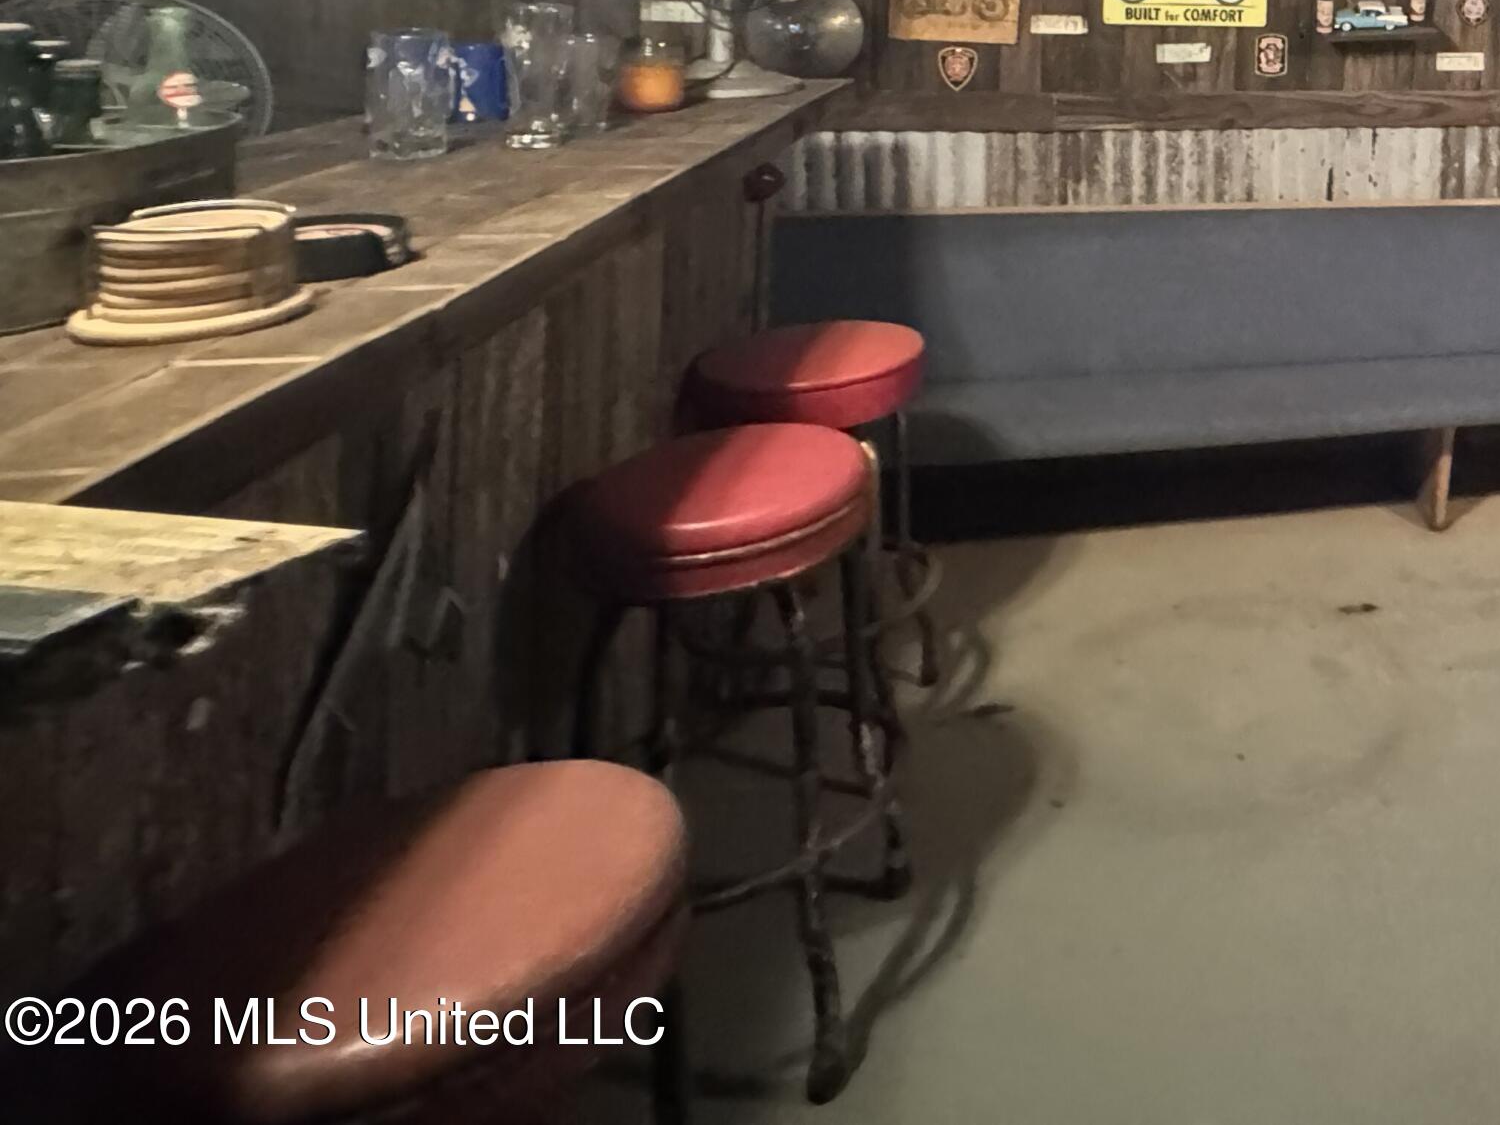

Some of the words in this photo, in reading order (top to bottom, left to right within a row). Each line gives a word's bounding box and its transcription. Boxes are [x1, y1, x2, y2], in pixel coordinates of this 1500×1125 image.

[1125, 7, 1161, 21] BUILT
[1165, 9, 1180, 21] for
[1183, 8, 1244, 22] COMFORT
